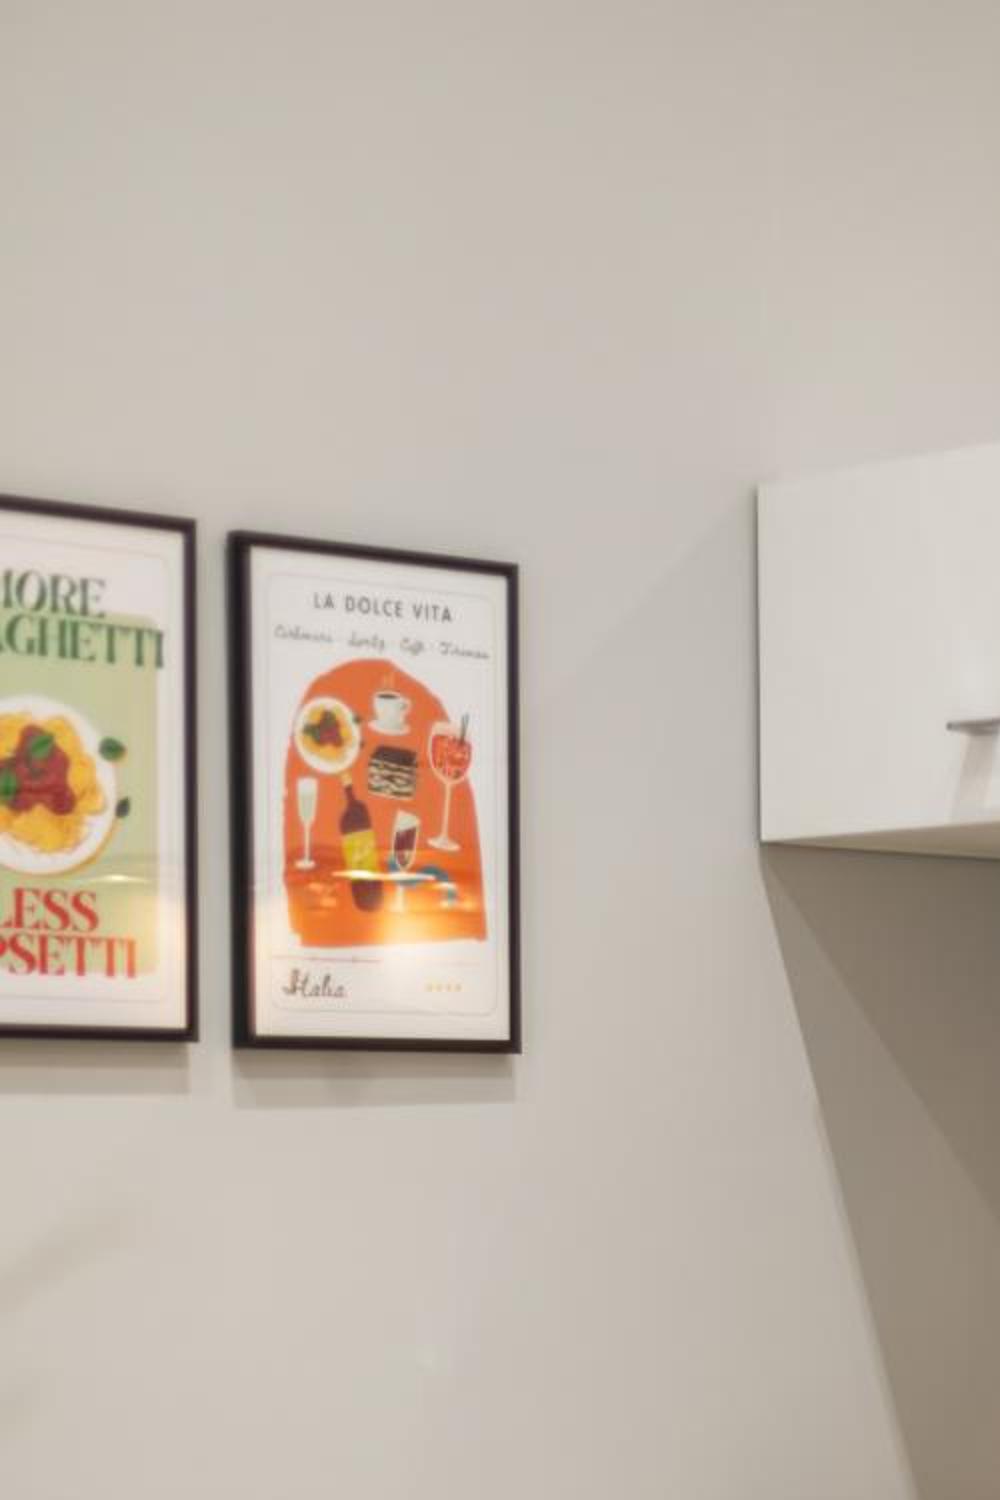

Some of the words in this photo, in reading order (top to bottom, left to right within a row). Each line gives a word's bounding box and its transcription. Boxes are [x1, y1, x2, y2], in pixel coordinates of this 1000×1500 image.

[313, 592, 335, 609] LA
[345, 596, 403, 618] DOLCE
[412, 603, 453, 622] VITA
[0, 613, 164, 669] GHETTI
[0, 887, 98, 932] ESS
